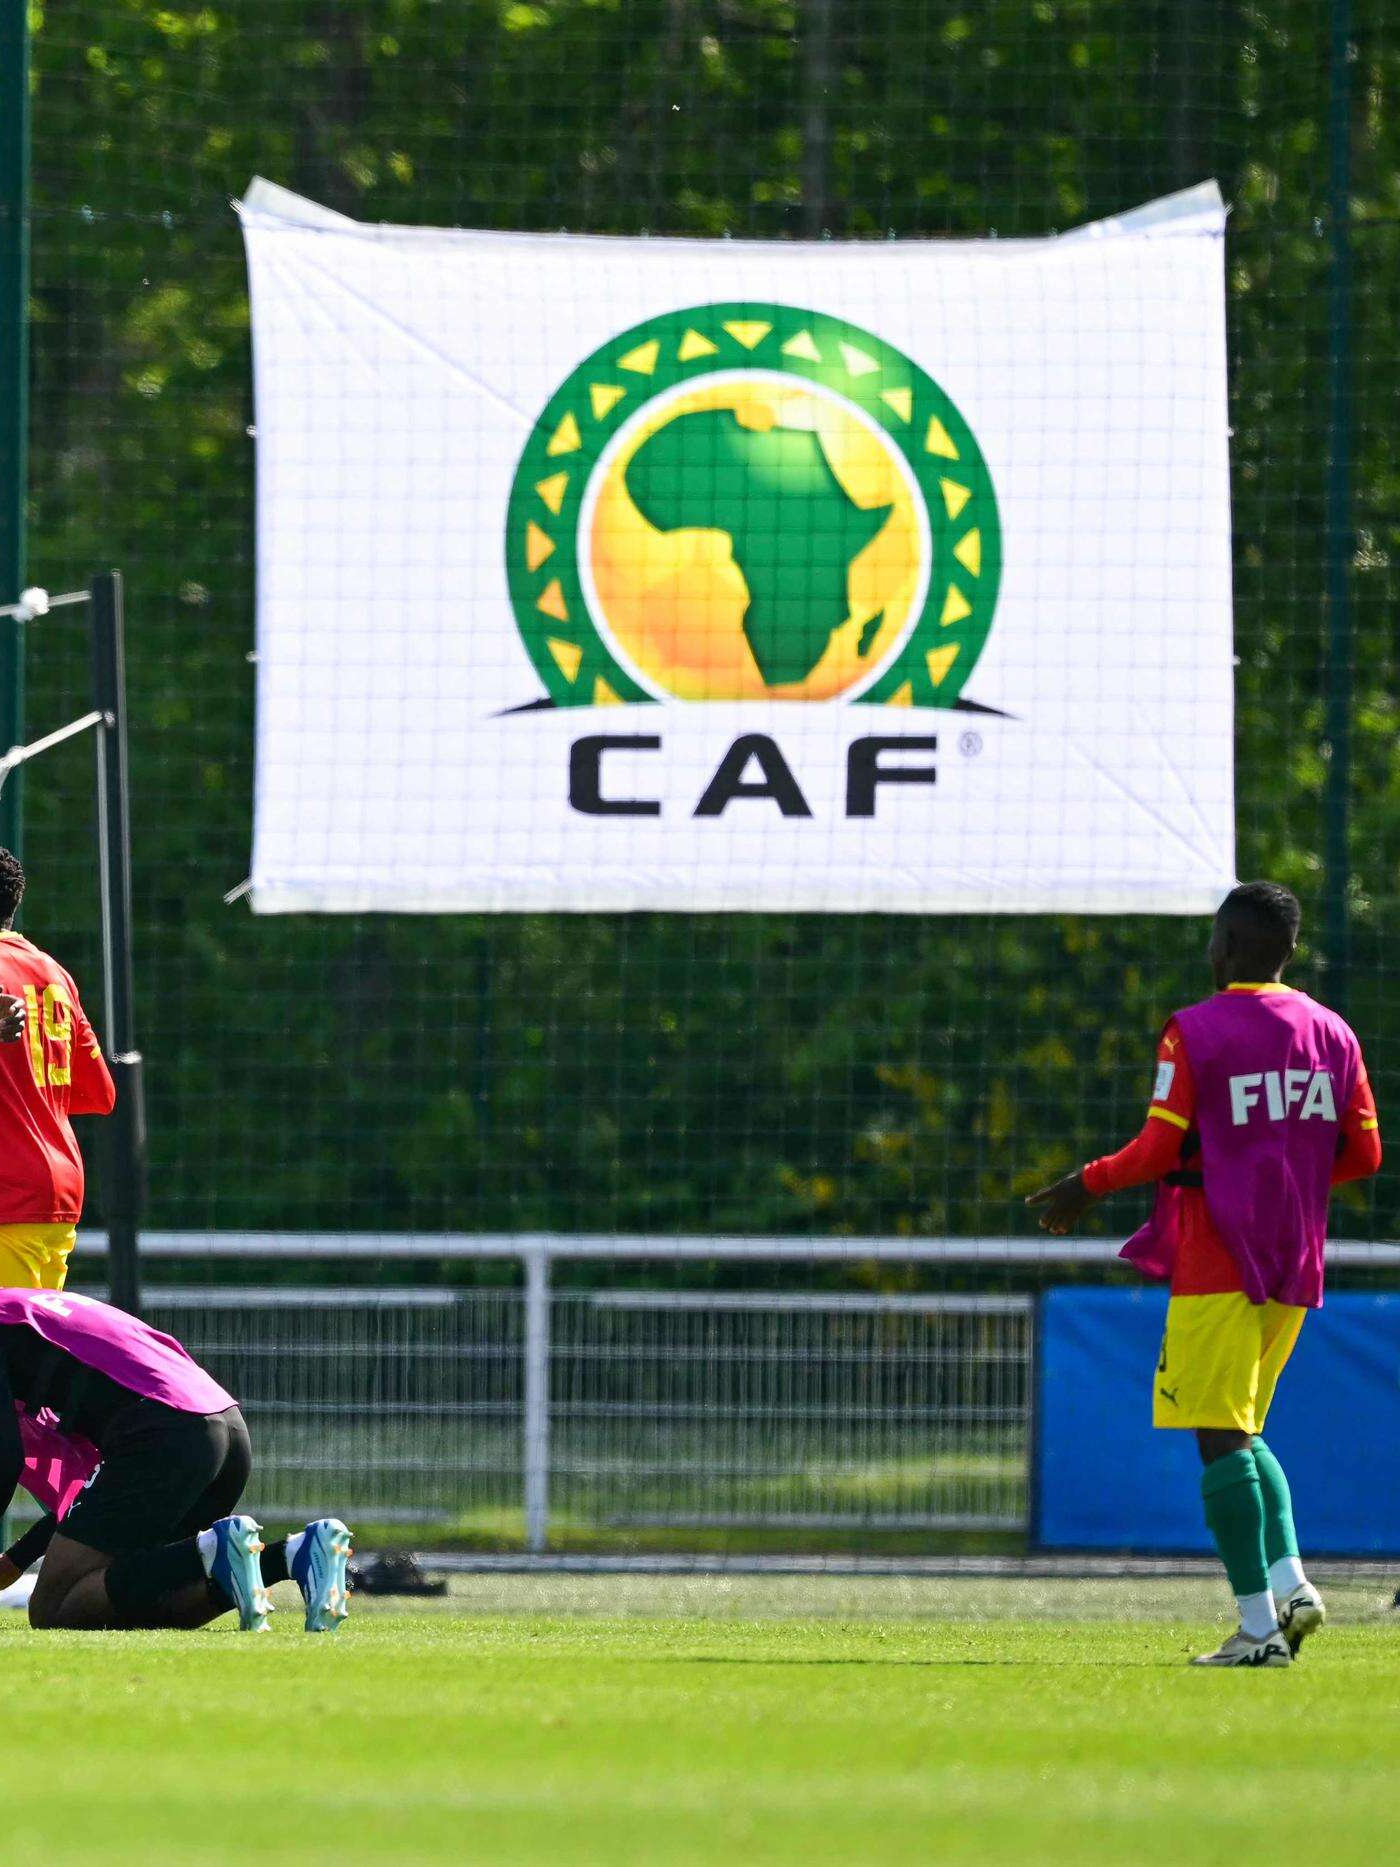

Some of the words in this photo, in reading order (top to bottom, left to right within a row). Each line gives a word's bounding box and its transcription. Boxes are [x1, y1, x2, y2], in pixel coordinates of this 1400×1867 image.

[568, 733, 937, 817] CAF
[22, 983, 72, 1088] 19
[1229, 1068, 1338, 1126] FIFA
